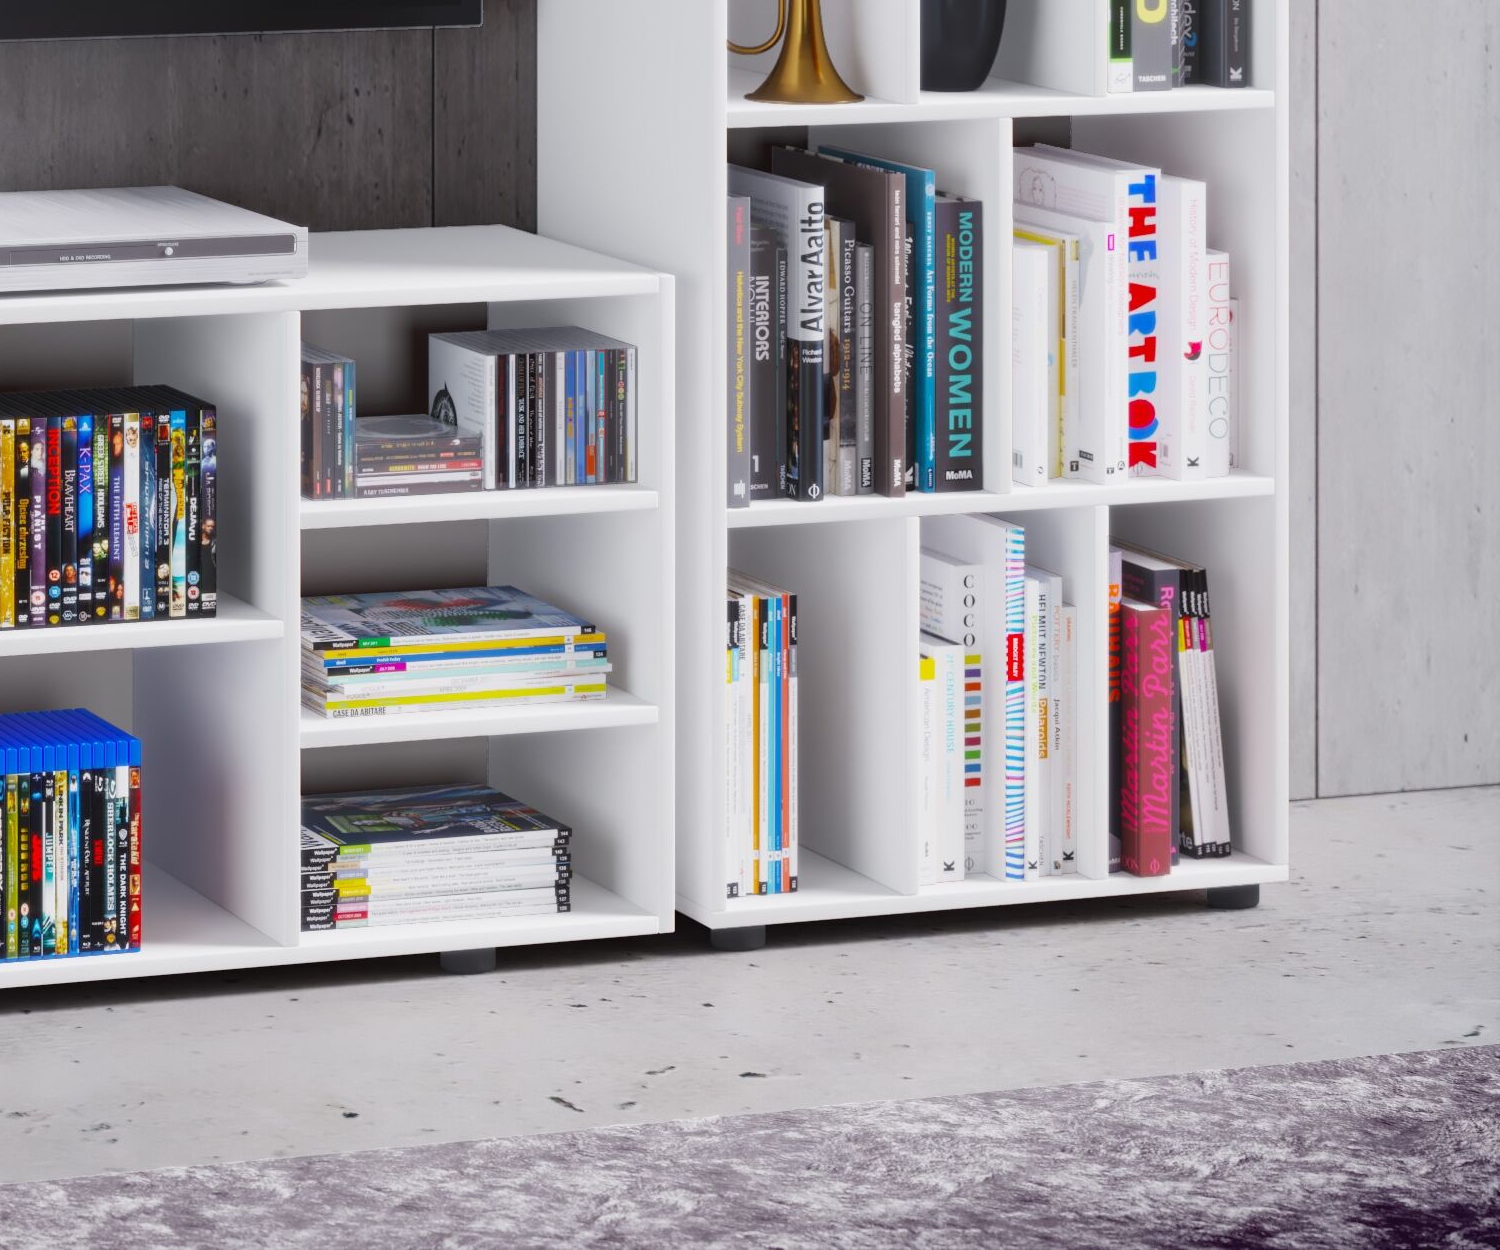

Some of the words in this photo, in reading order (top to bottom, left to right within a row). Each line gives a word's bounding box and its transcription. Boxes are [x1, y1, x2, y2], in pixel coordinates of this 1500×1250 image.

[800, 202, 824, 266] Aalto
[1129, 174, 1157, 263] THE
[1188, 199, 1198, 235] History
[843, 239, 855, 283] Picasso
[959, 212, 973, 302] MODERN
[1117, 237, 1126, 250] for
[1189, 238, 1198, 249] of
[1117, 253, 1126, 287] fashion
[1189, 251, 1198, 292] Modern
[756, 276, 769, 361] INTERIORS
[800, 270, 823, 332] Alvar
[843, 286, 855, 334] Guitars
[860, 302, 872, 327] ON
[1116, 290, 1126, 335] designers
[1187, 295, 1198, 331] Design
[892, 302, 902, 341] tangled
[1129, 282, 1157, 362] ART
[860, 337, 872, 375] LINE
[892, 344, 902, 393] alphabets
[1208, 262, 1228, 439] EURODECO
[736, 376, 744, 390] City
[949, 308, 973, 459] WOMEN
[736, 392, 744, 419] Subway
[97, 434, 105, 458] GREEN
[736, 421, 744, 452] System
[48, 429, 60, 515] INCEPTION
[79, 447, 90, 494] K-PAX
[97, 460, 105, 486] STREET
[862, 459, 871, 486] MoMA
[894, 459, 902, 487] MoMA
[946, 469, 973, 481] MoMA
[3, 492, 11, 515] PULP
[64, 470, 76, 532] BRAVEHEART
[97, 489, 105, 528] HOOLIGANS
[3, 518, 11, 554] FICTION
[164, 537, 169, 546] 3
[739, 622, 746, 631] DA
[963, 574, 976, 647] COCO
[1142, 614, 1169, 698] Parr
[332, 709, 349, 718] CASE
[350, 708, 358, 717] DA
[360, 706, 386, 716] ABITARE
[923, 688, 931, 732] American
[946, 671, 955, 717] CENTURY
[922, 735, 931, 762] Design
[946, 720, 955, 754] HOUSE
[1039, 699, 1048, 759] Polaroids
[1142, 707, 1170, 833] Martin
[107, 802, 115, 862] SHERLOCK
[107, 864, 115, 910] HOLMES
